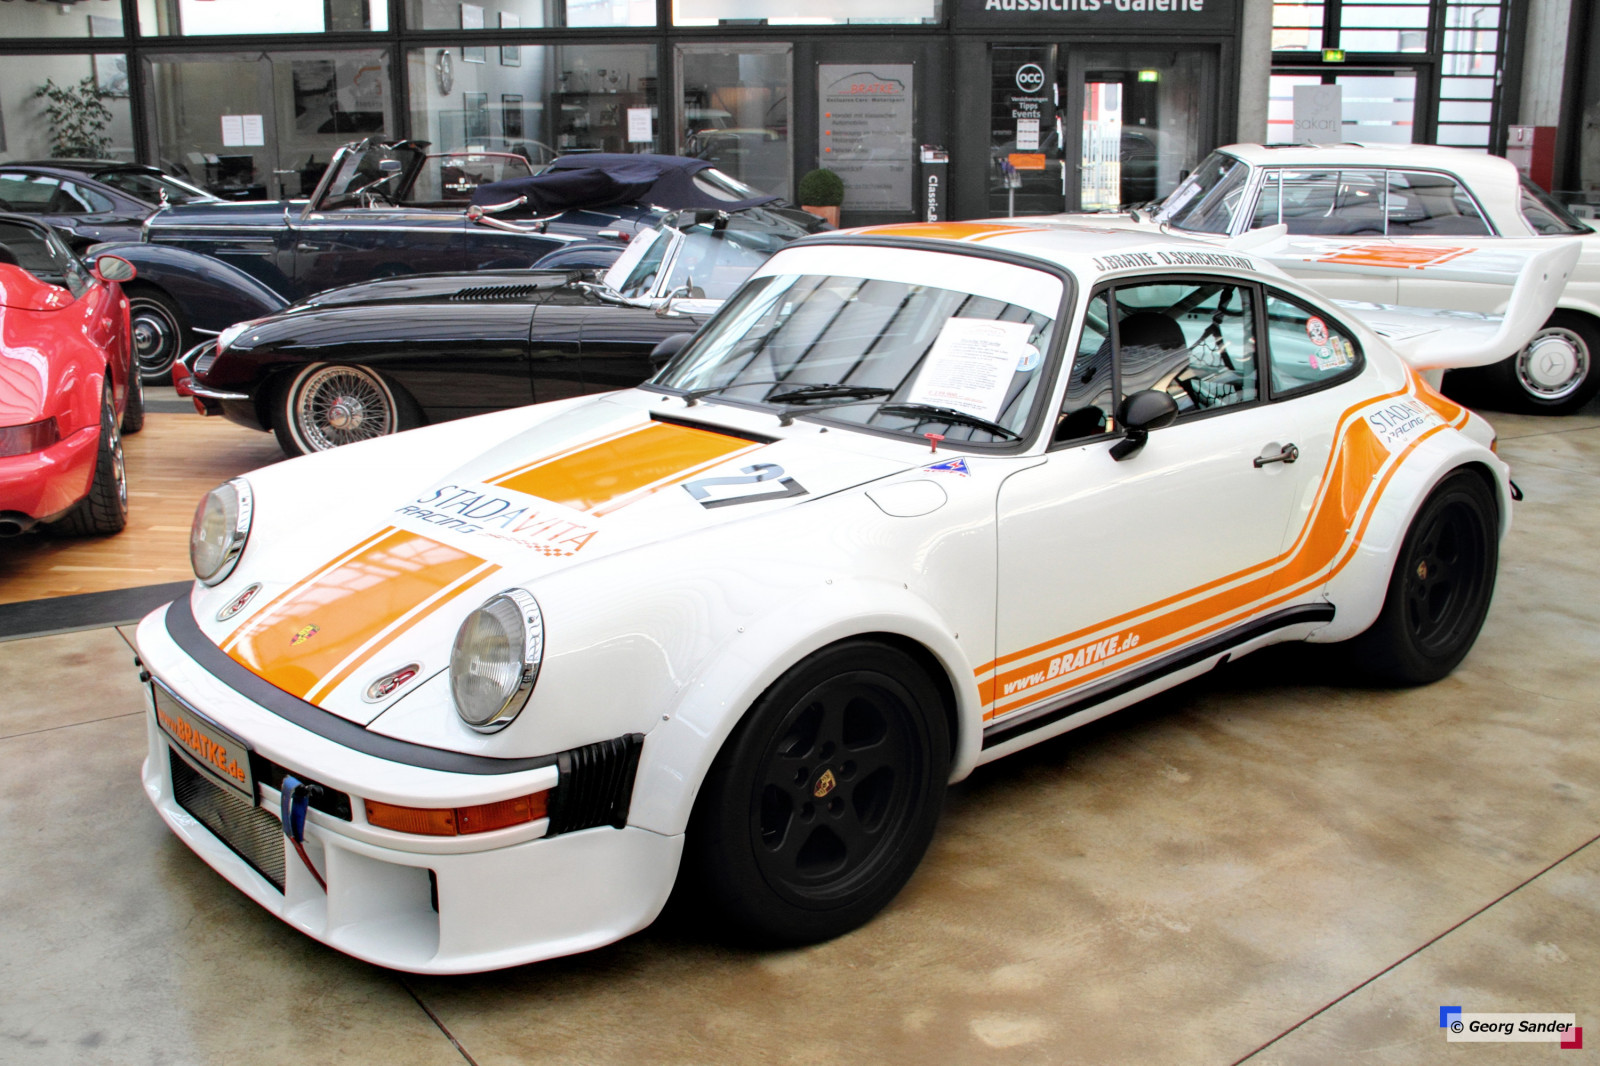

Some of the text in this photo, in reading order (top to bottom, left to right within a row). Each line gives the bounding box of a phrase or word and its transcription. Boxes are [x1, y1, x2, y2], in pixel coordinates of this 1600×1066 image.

[1019, 73, 1041, 84] OCC
[1012, 110, 1041, 119] Events
[1019, 102, 1038, 112] Tipps
[1092, 251, 1256, 271] J.BRATKE D.SCHICKENTANZ
[394, 505, 484, 534] RACING
[417, 485, 599, 552] STADAVITA
[1003, 632, 1140, 695] www.BRATKE.de
[158, 708, 246, 783] www.BRATKE.de
